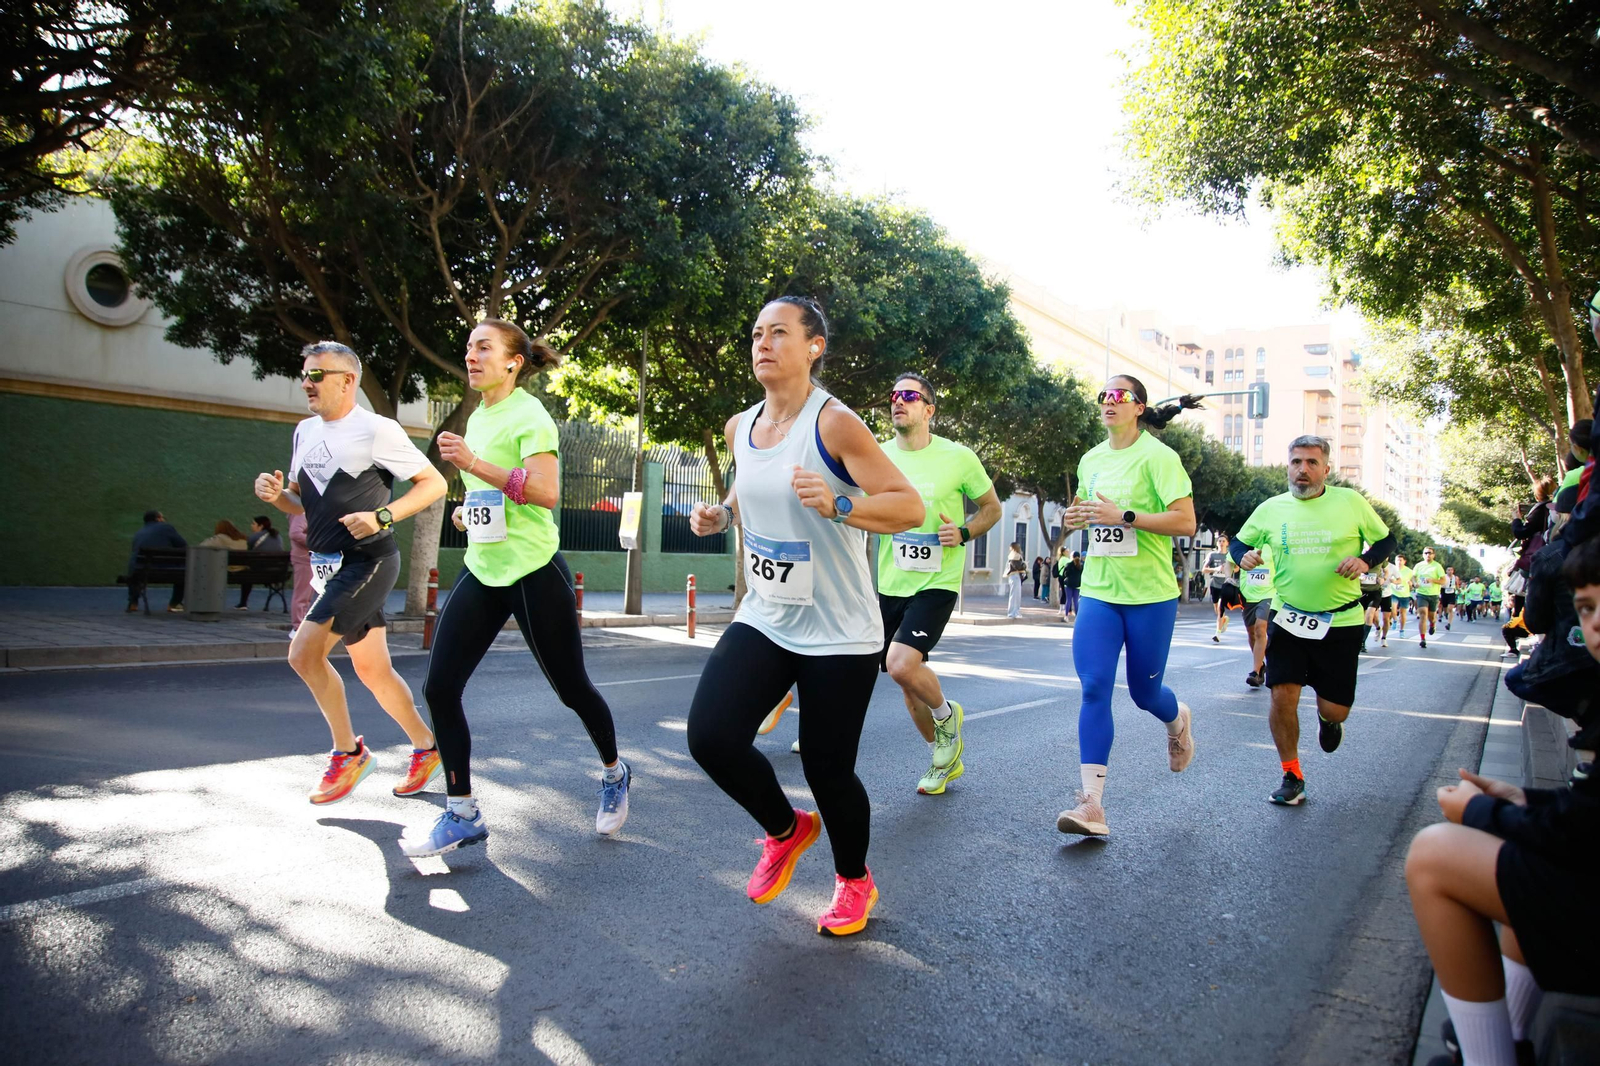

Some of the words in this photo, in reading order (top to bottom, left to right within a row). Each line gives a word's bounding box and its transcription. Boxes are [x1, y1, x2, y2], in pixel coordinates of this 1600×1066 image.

[468, 507, 492, 526] 158
[1095, 528, 1123, 542] 329
[900, 544, 931, 560] 139
[1292, 545, 1331, 554] cáncer
[751, 553, 794, 583] 267
[1286, 612, 1319, 630] 319
